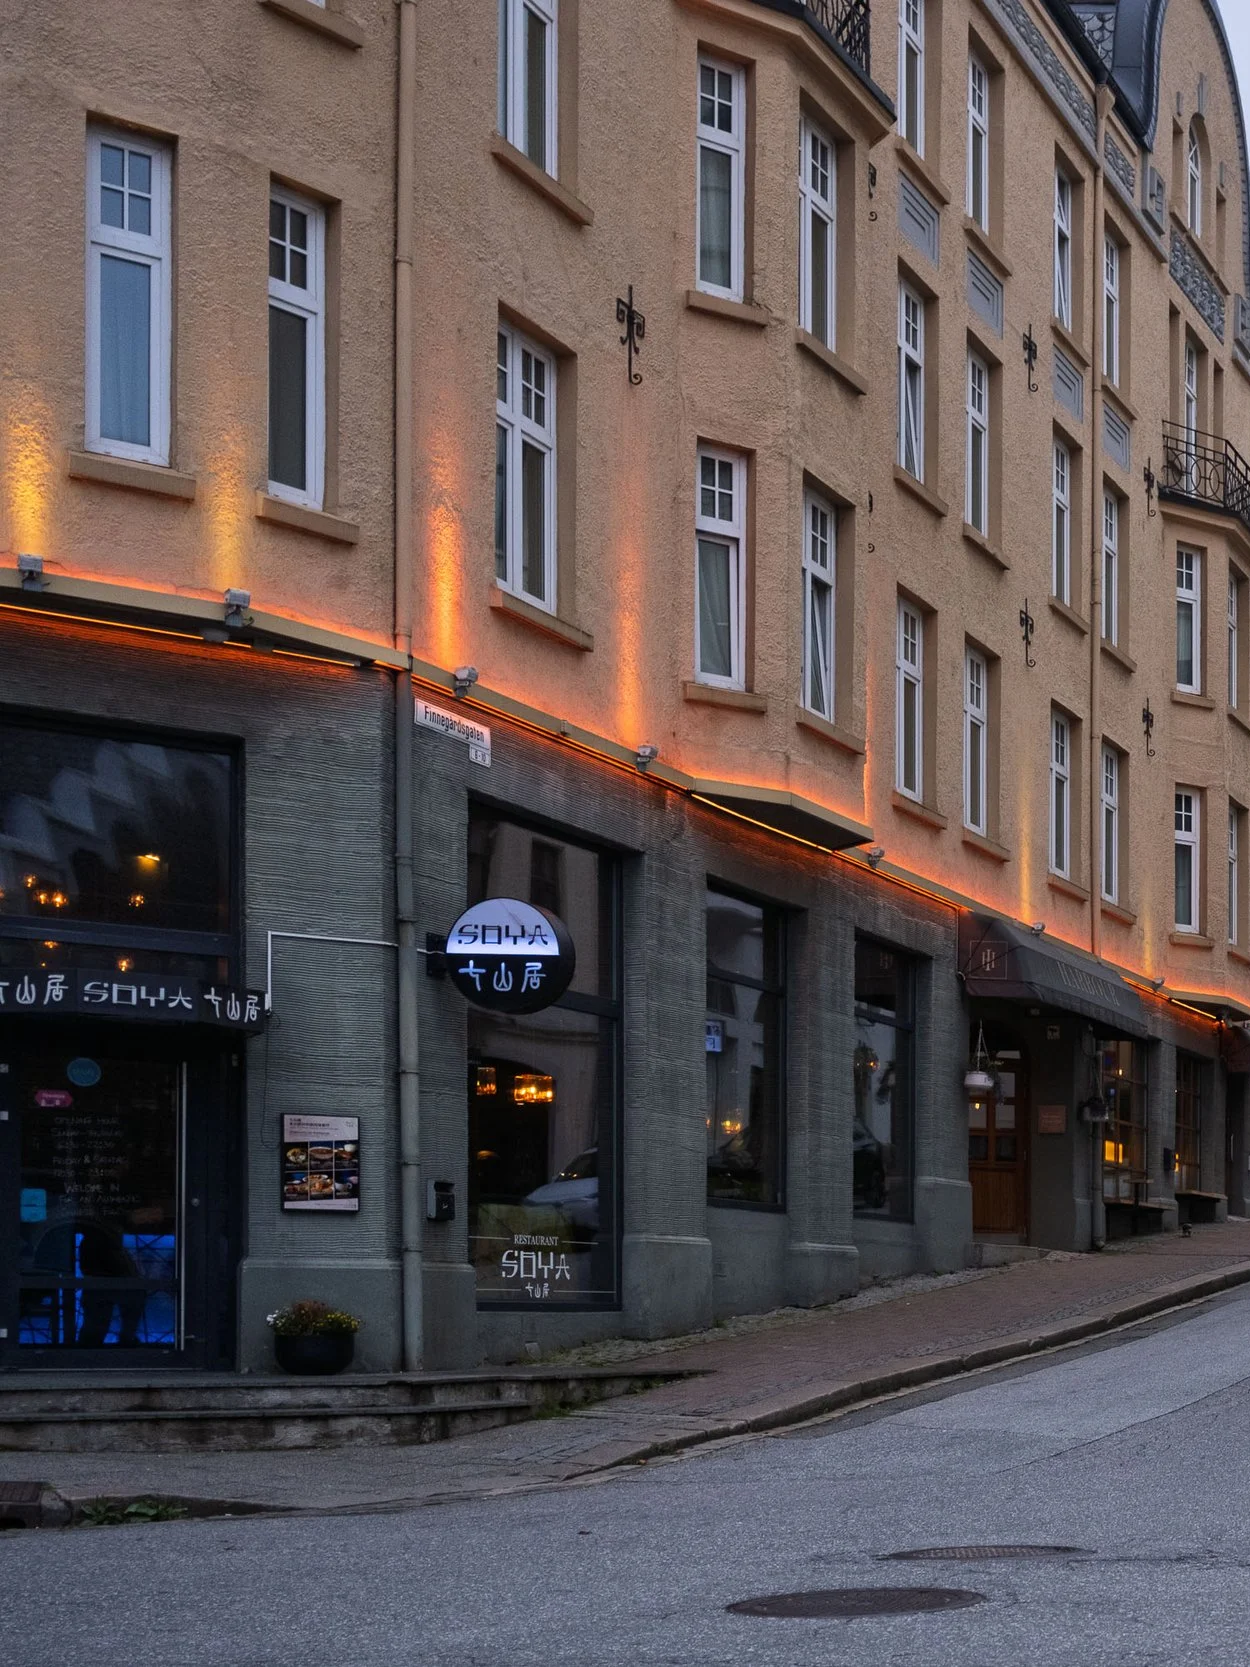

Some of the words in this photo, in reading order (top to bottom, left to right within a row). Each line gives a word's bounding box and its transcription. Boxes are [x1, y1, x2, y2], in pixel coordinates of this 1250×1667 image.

[424, 706, 485, 742] Finnegårdsgaten
[457, 924, 549, 946] SOYA
[83, 981, 193, 1009] SOYA
[1056, 961, 1120, 1007] HARBOUR
[514, 1234, 559, 1246] RESTAURANT
[502, 1249, 571, 1280] SOYA
